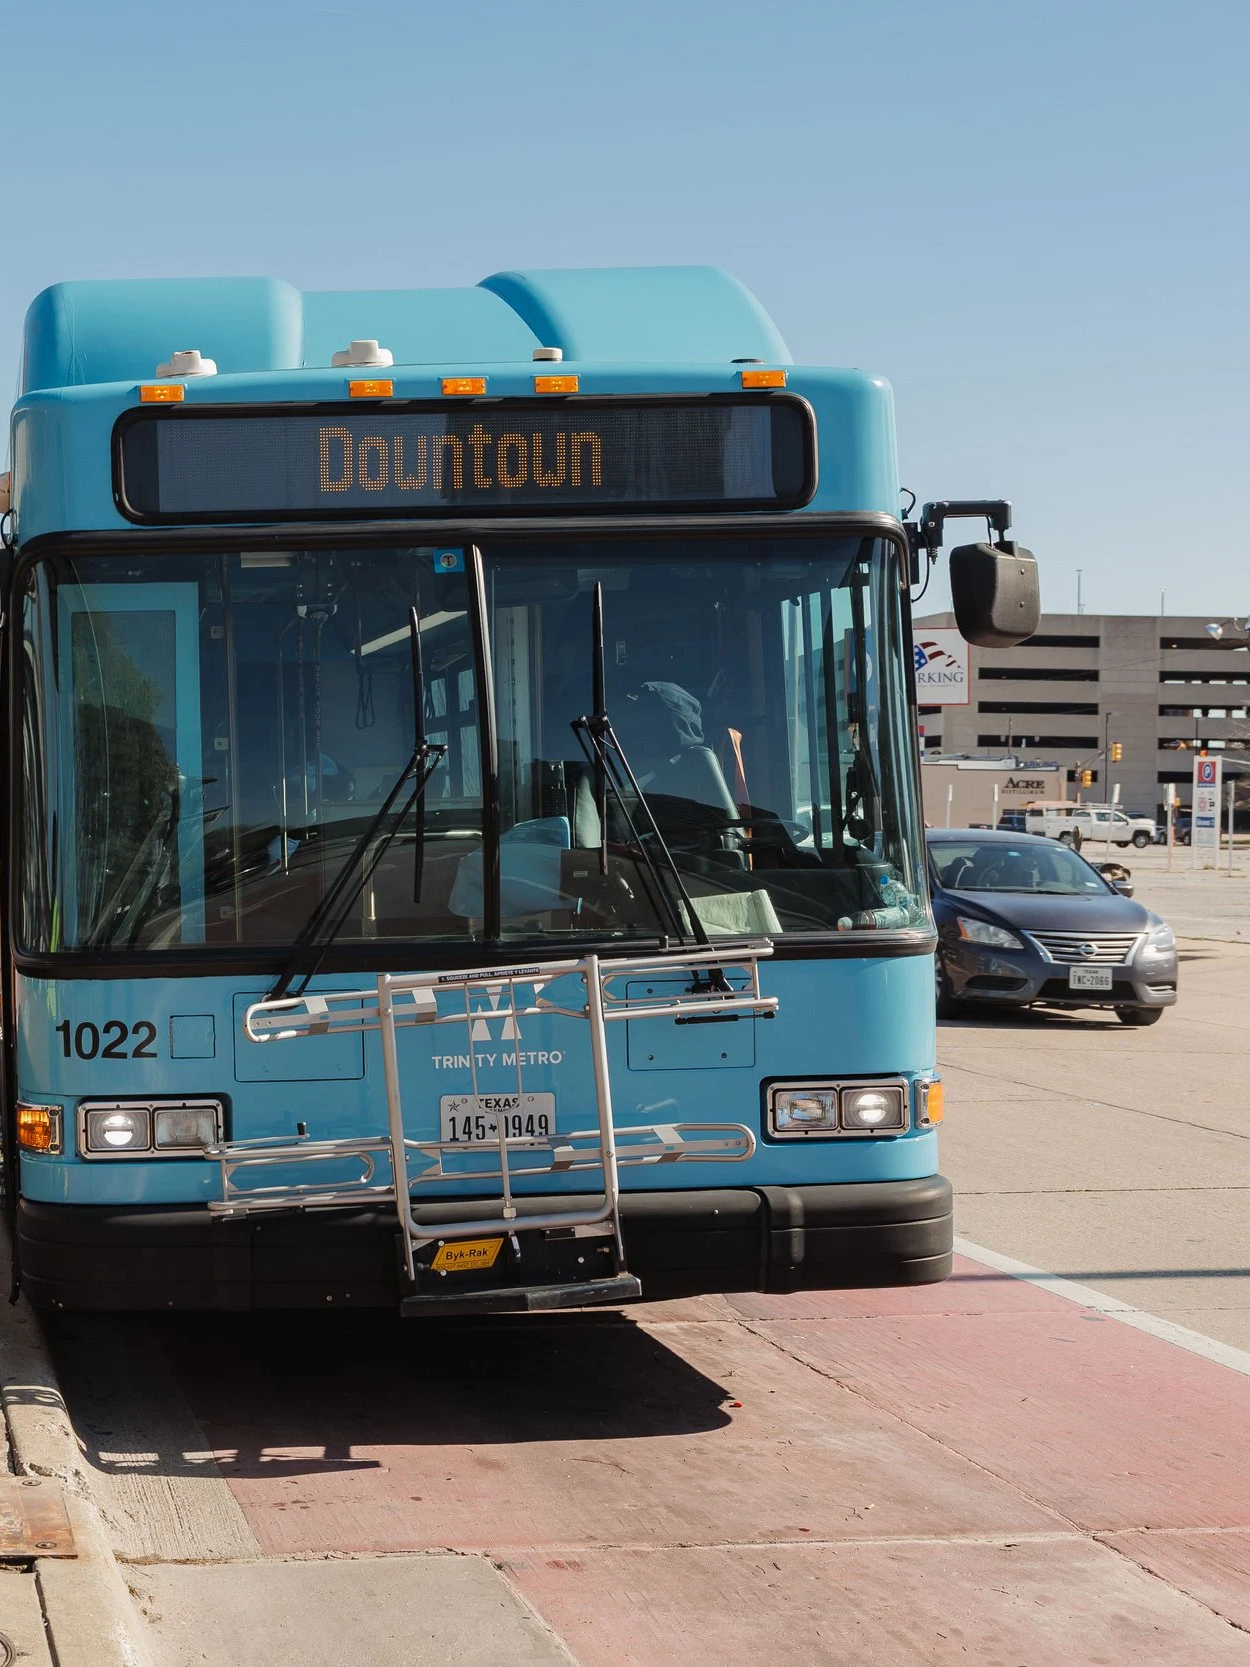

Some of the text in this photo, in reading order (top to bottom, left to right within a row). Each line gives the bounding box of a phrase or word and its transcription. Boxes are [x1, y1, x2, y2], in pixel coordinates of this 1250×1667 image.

[318, 424, 602, 492] Downtown
[55, 1019, 158, 1060] 1022
[431, 1050, 563, 1069] TRINTY METRO
[445, 1248, 488, 1261] Byk-Rak
